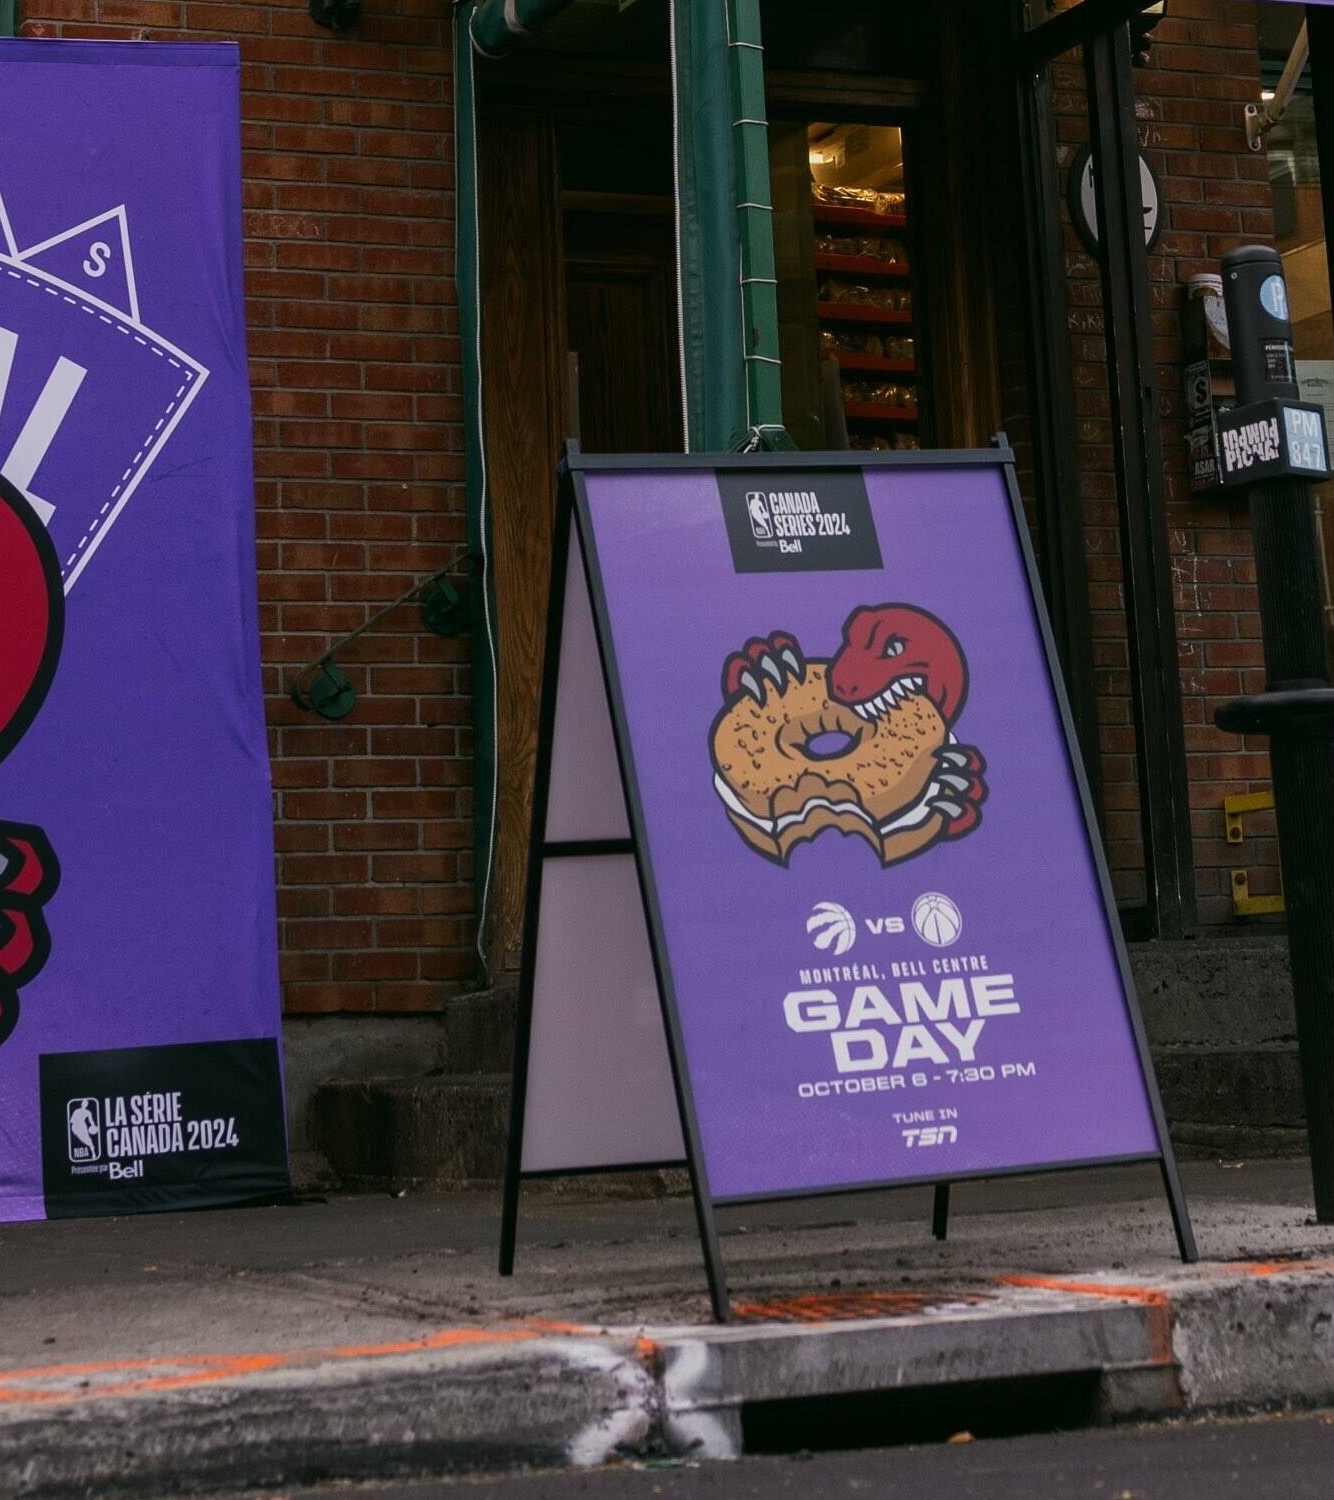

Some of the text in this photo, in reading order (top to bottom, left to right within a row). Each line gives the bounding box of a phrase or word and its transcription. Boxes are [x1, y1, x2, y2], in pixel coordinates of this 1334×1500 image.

[1291, 411, 1319, 438] PM
[1293, 440, 1321, 469] 847
[769, 491, 821, 514] CANADA
[773, 512, 851, 537] SERIES 2024
[779, 538, 803, 553] Bell
[799, 955, 989, 985] MONTRÉAL, BELL CENTRE
[783, 973, 1021, 1033] GAME
[830, 1019, 986, 1073] DAY
[798, 1074, 906, 1098] OCTOBER
[911, 1072, 928, 1087] 6
[945, 1066, 995, 1084] 7:30
[1001, 1062, 1036, 1080] PM
[105, 1091, 183, 1127] LA SÉRIE
[892, 1107, 958, 1124] TUNE IN
[106, 1117, 239, 1158] CANADA 2024
[902, 1125, 958, 1148] TSN
[109, 1159, 144, 1180] Bell
